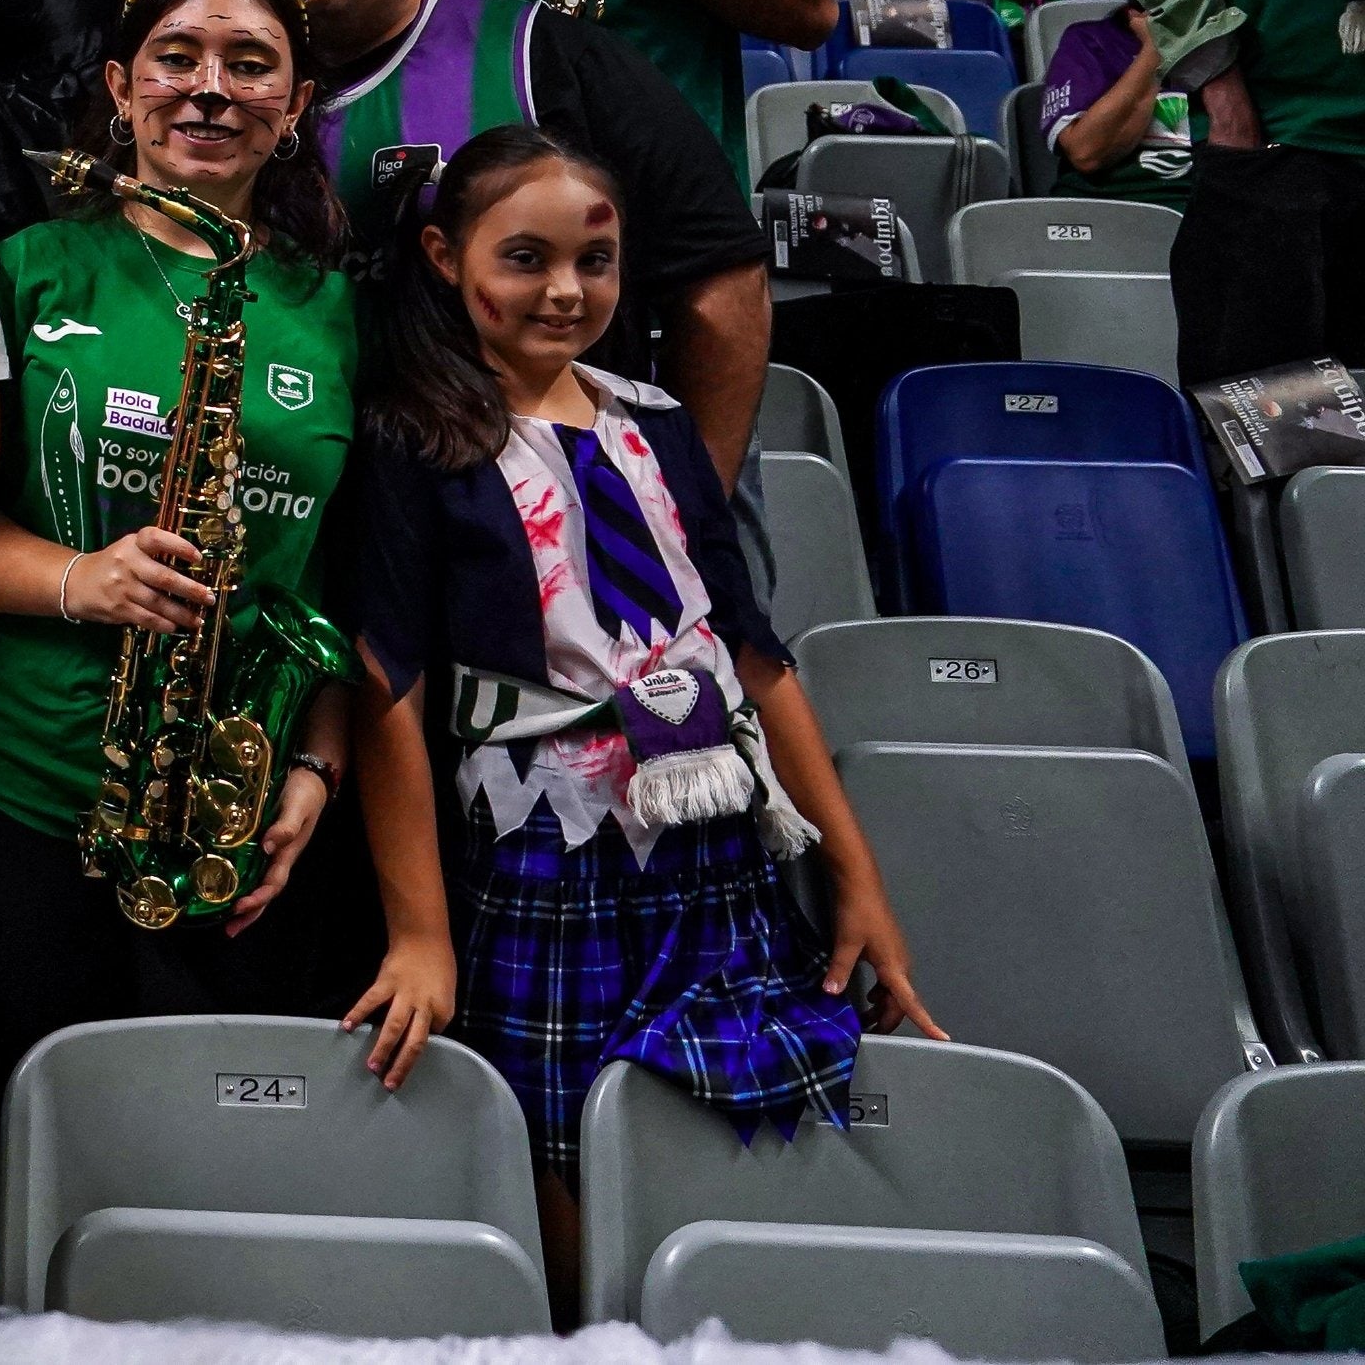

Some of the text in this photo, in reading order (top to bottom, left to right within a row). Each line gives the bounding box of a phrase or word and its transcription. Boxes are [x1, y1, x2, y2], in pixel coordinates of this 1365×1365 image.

[378, 160, 403, 173] liga
[871, 198, 896, 265] Equipo
[1058, 226, 1080, 238] 28
[113, 392, 152, 409] Hola
[1019, 396, 1045, 410] 27
[98, 438, 121, 456] Yo
[126, 447, 160, 466] soy
[946, 661, 980, 680] 26
[239, 1077, 283, 1102] 24
